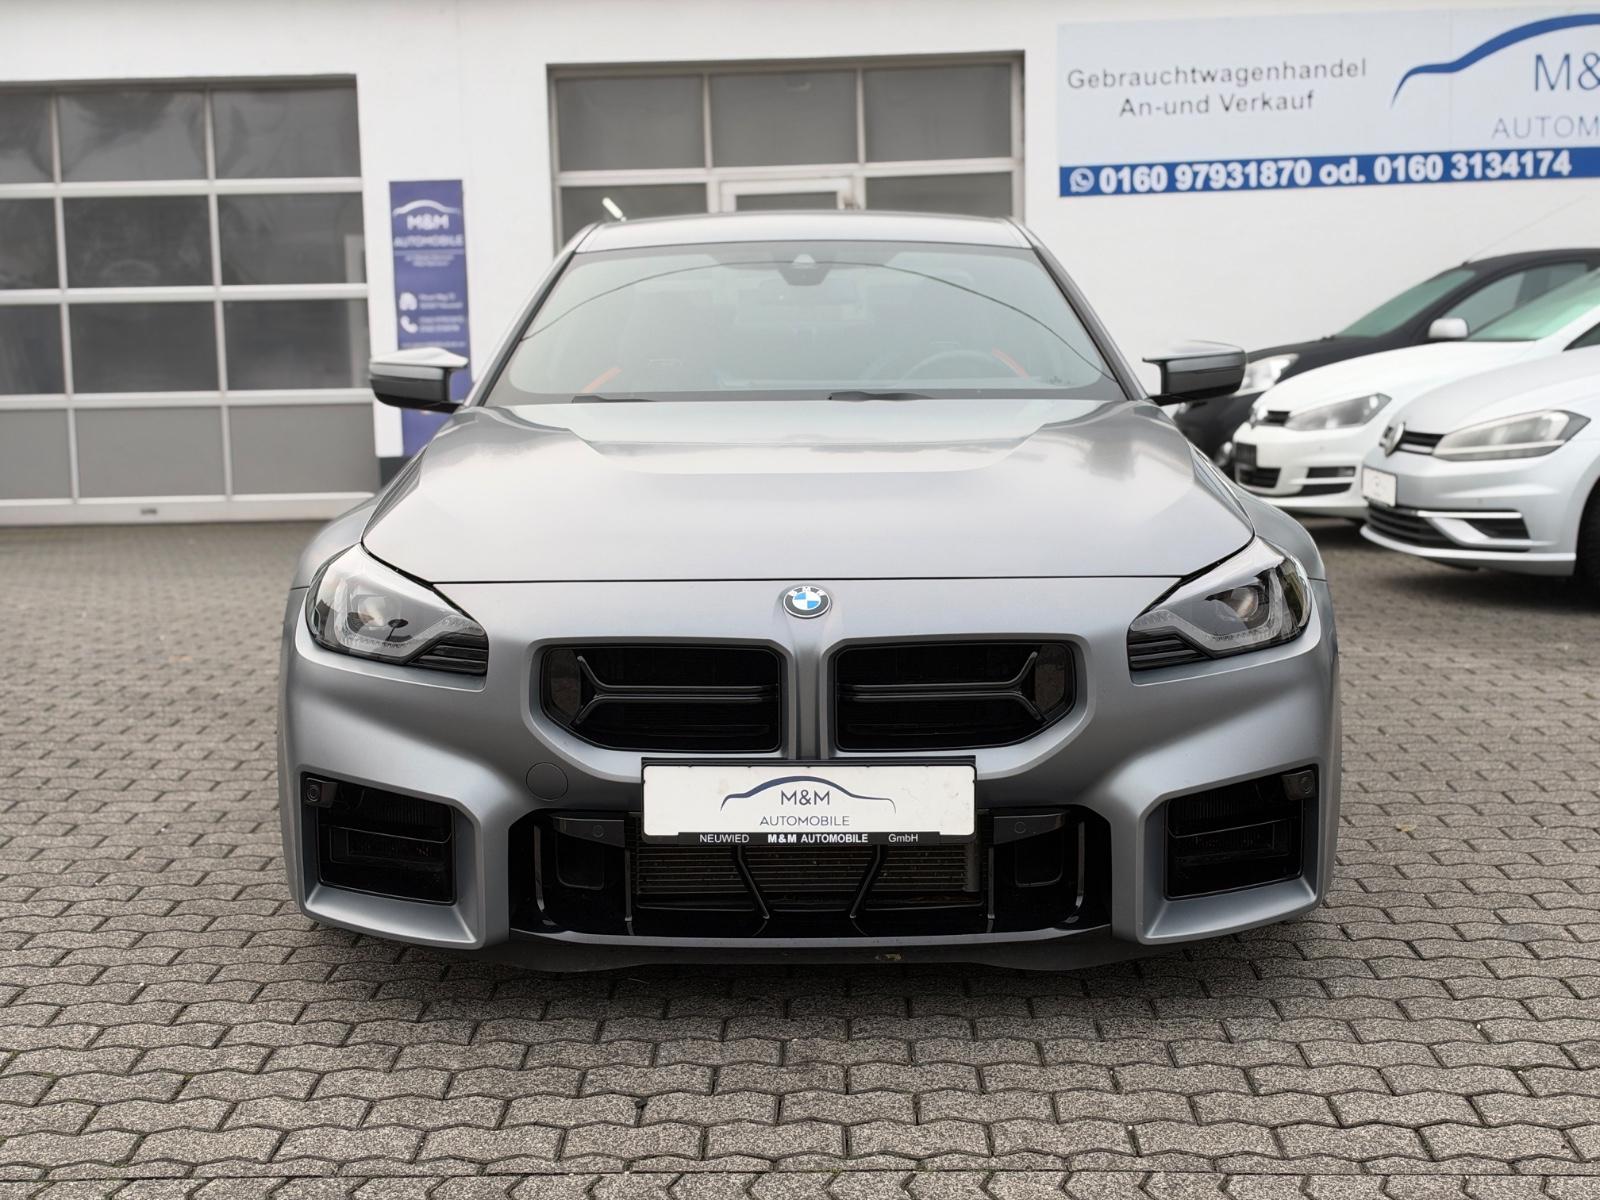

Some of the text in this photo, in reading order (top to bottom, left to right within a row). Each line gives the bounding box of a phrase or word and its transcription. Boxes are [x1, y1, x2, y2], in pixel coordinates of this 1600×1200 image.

[1067, 57, 1367, 89] Gebrauchtwagenhandel
[1119, 89, 1315, 117] An-und Verkauf
[1099, 149, 1572, 194] 0160 97931870 od. 0160 3134174
[406, 212, 450, 231] M&M
[788, 585, 827, 597] BMW
[780, 789, 831, 806] M&M
[759, 815, 850, 827] AUTOMOBILE
[699, 833, 919, 843] NEUWIED M&M AUTOMOBILE GmbH
